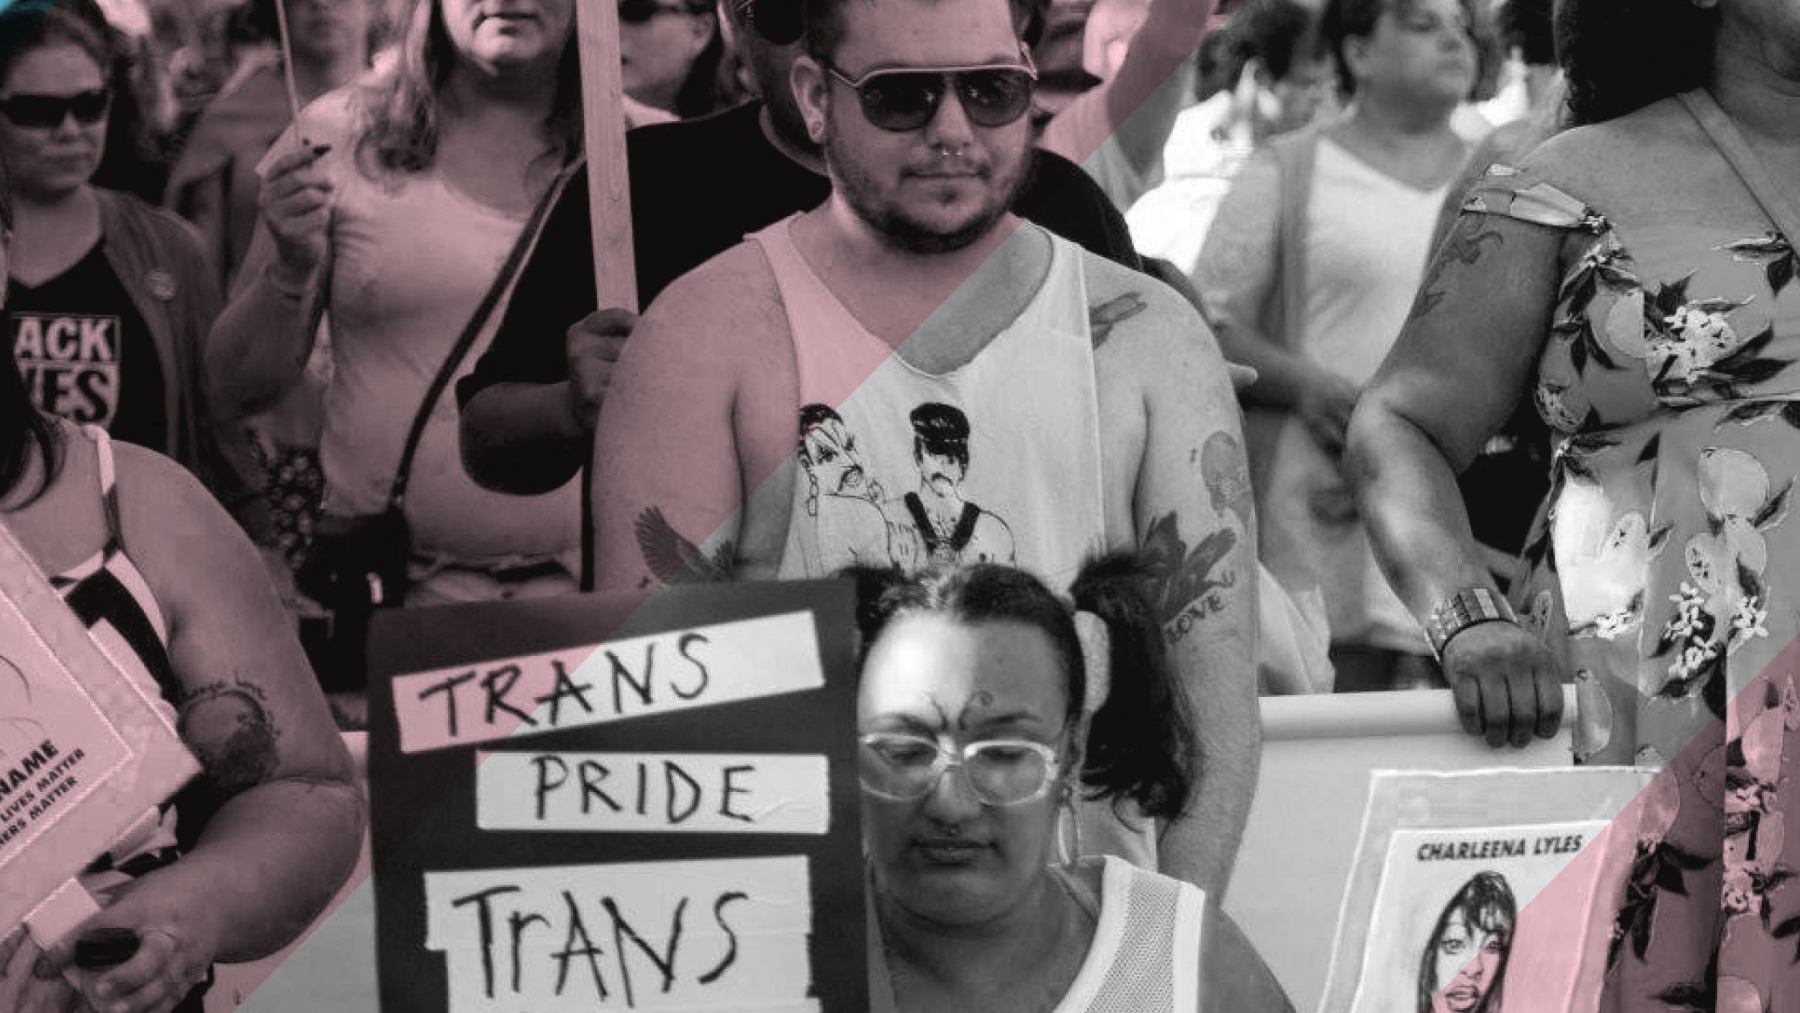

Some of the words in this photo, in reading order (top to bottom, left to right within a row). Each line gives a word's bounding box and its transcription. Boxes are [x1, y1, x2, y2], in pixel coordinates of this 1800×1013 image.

[13, 316, 113, 361] ACK
[418, 633, 710, 737] TRANS
[36, 747, 85, 793] MATTER
[529, 754, 757, 824] PRIDE
[28, 775, 78, 821] MATTER
[1416, 838, 1526, 862] CHARLEENA
[1533, 834, 1583, 856] LYLES
